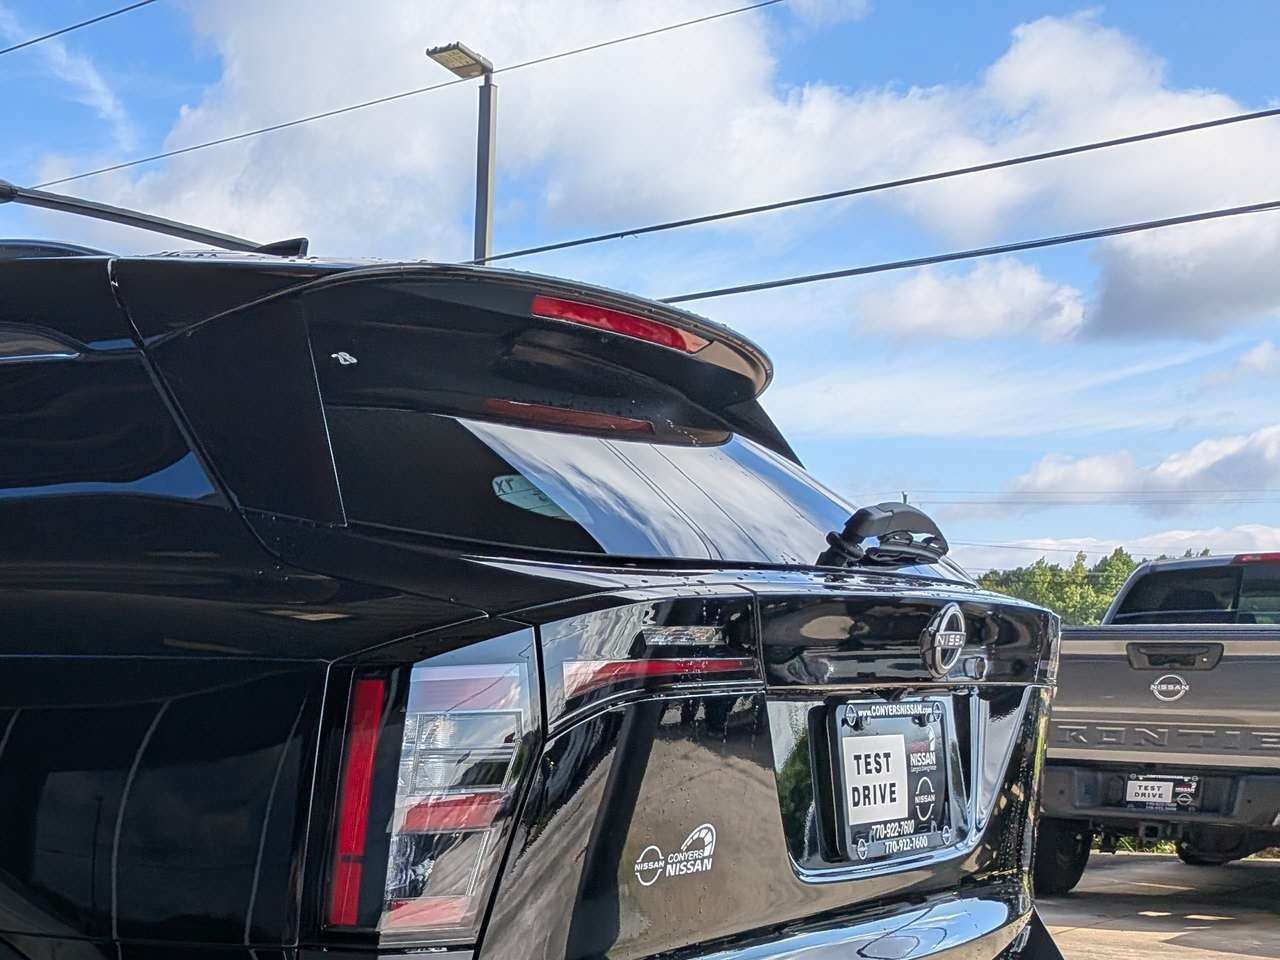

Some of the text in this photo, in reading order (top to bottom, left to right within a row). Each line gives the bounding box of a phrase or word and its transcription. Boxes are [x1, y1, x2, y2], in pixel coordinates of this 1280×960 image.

[857, 704, 933, 717] www.CONYERSNISSAN.com
[853, 752, 892, 775] TEST
[910, 752, 936, 767] NISSAN
[851, 782, 897, 808] DRIVE
[915, 794, 936, 803] NISSAN
[884, 836, 928, 854] 770-922-7600
[667, 849, 704, 863] CONYERS
[634, 860, 665, 872] NISSAN
[665, 858, 713, 877] NISSAN
